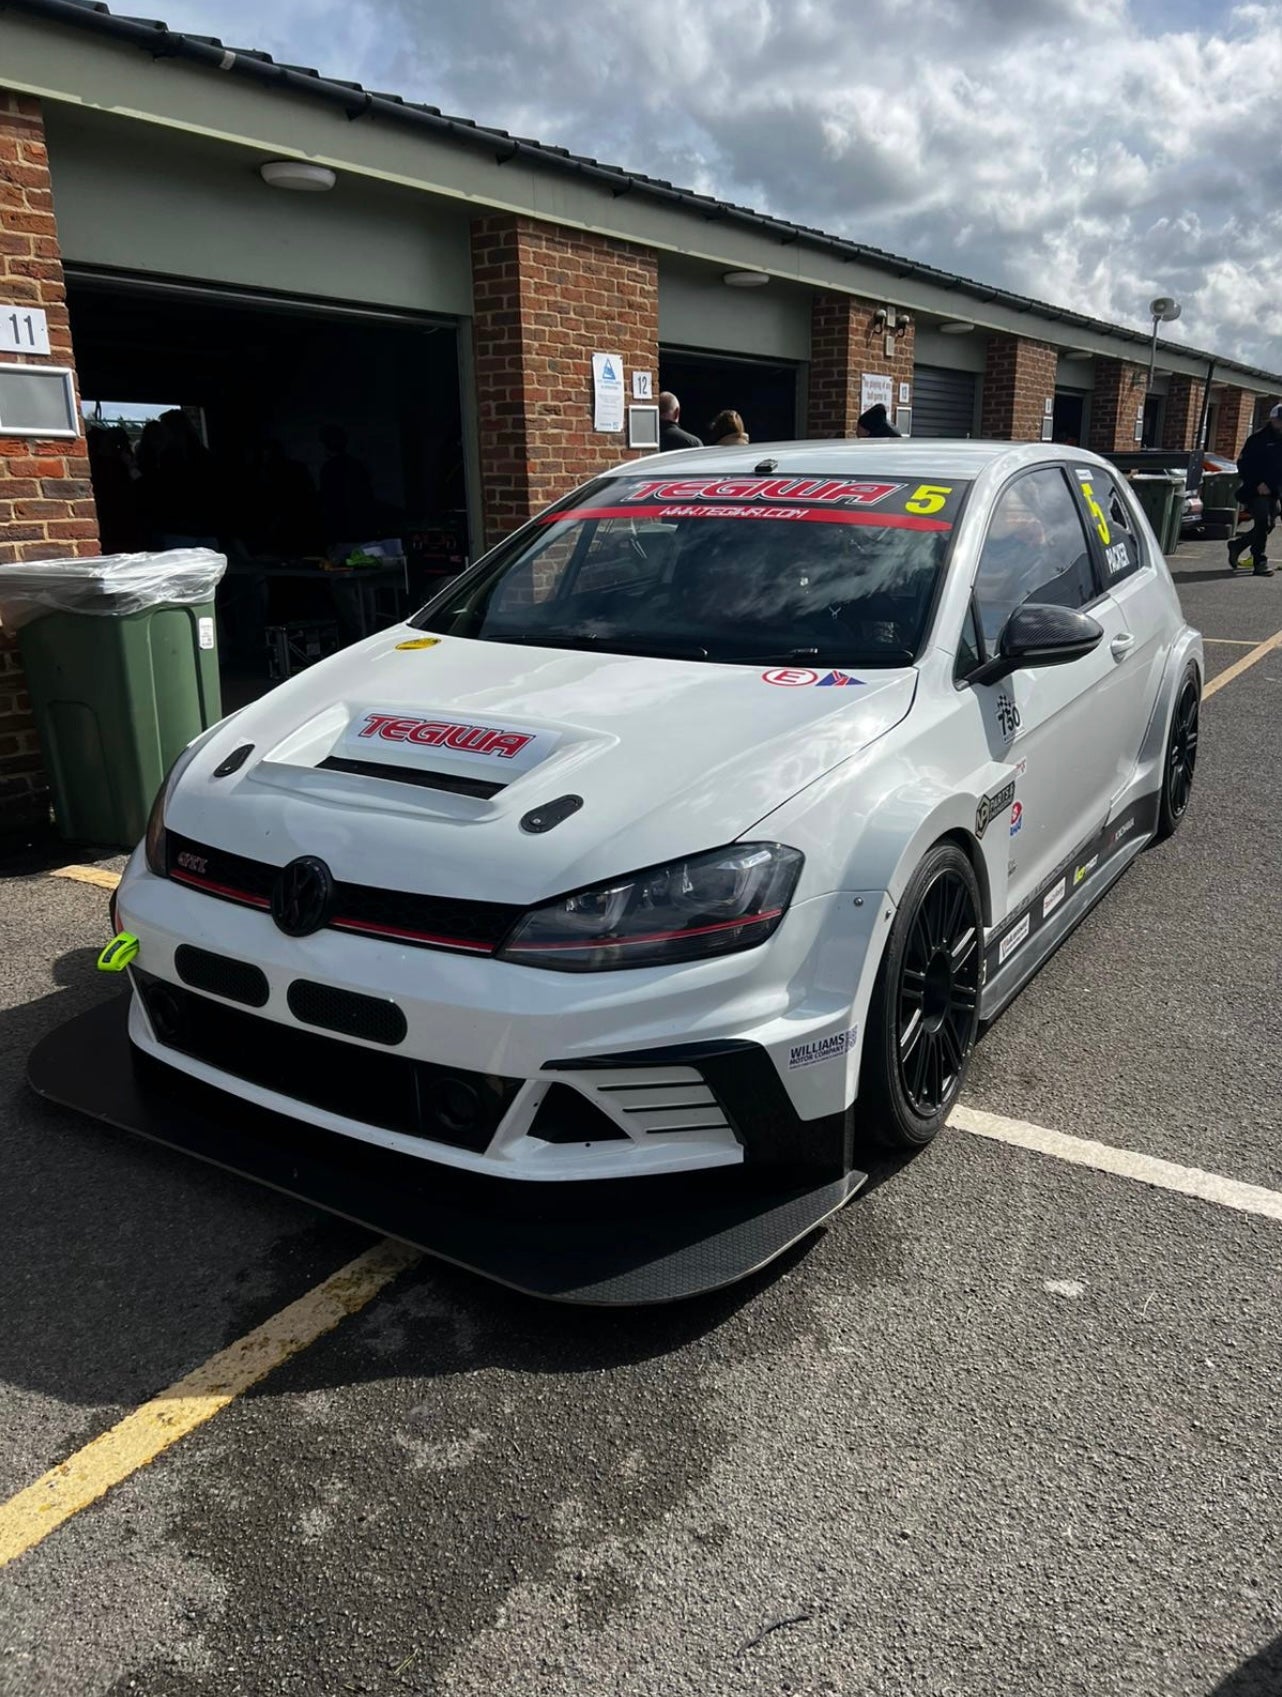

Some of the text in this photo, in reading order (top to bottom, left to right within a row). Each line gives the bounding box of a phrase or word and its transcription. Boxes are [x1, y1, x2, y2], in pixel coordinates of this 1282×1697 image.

[9, 313, 36, 346] 11
[638, 376, 648, 395] 12
[621, 476, 908, 506] TEGIWA
[905, 485, 952, 514] 5
[659, 505, 810, 520] WWW.TEGIWA.COM
[1081, 483, 1110, 545] 5
[773, 671, 806, 683] E
[998, 706, 1020, 735] 750
[358, 713, 536, 758] TEGIWA
[789, 1054, 813, 1065] MOTOR
[815, 1045, 844, 1059] COMPANY
[791, 1033, 845, 1058] WILLIAMS
